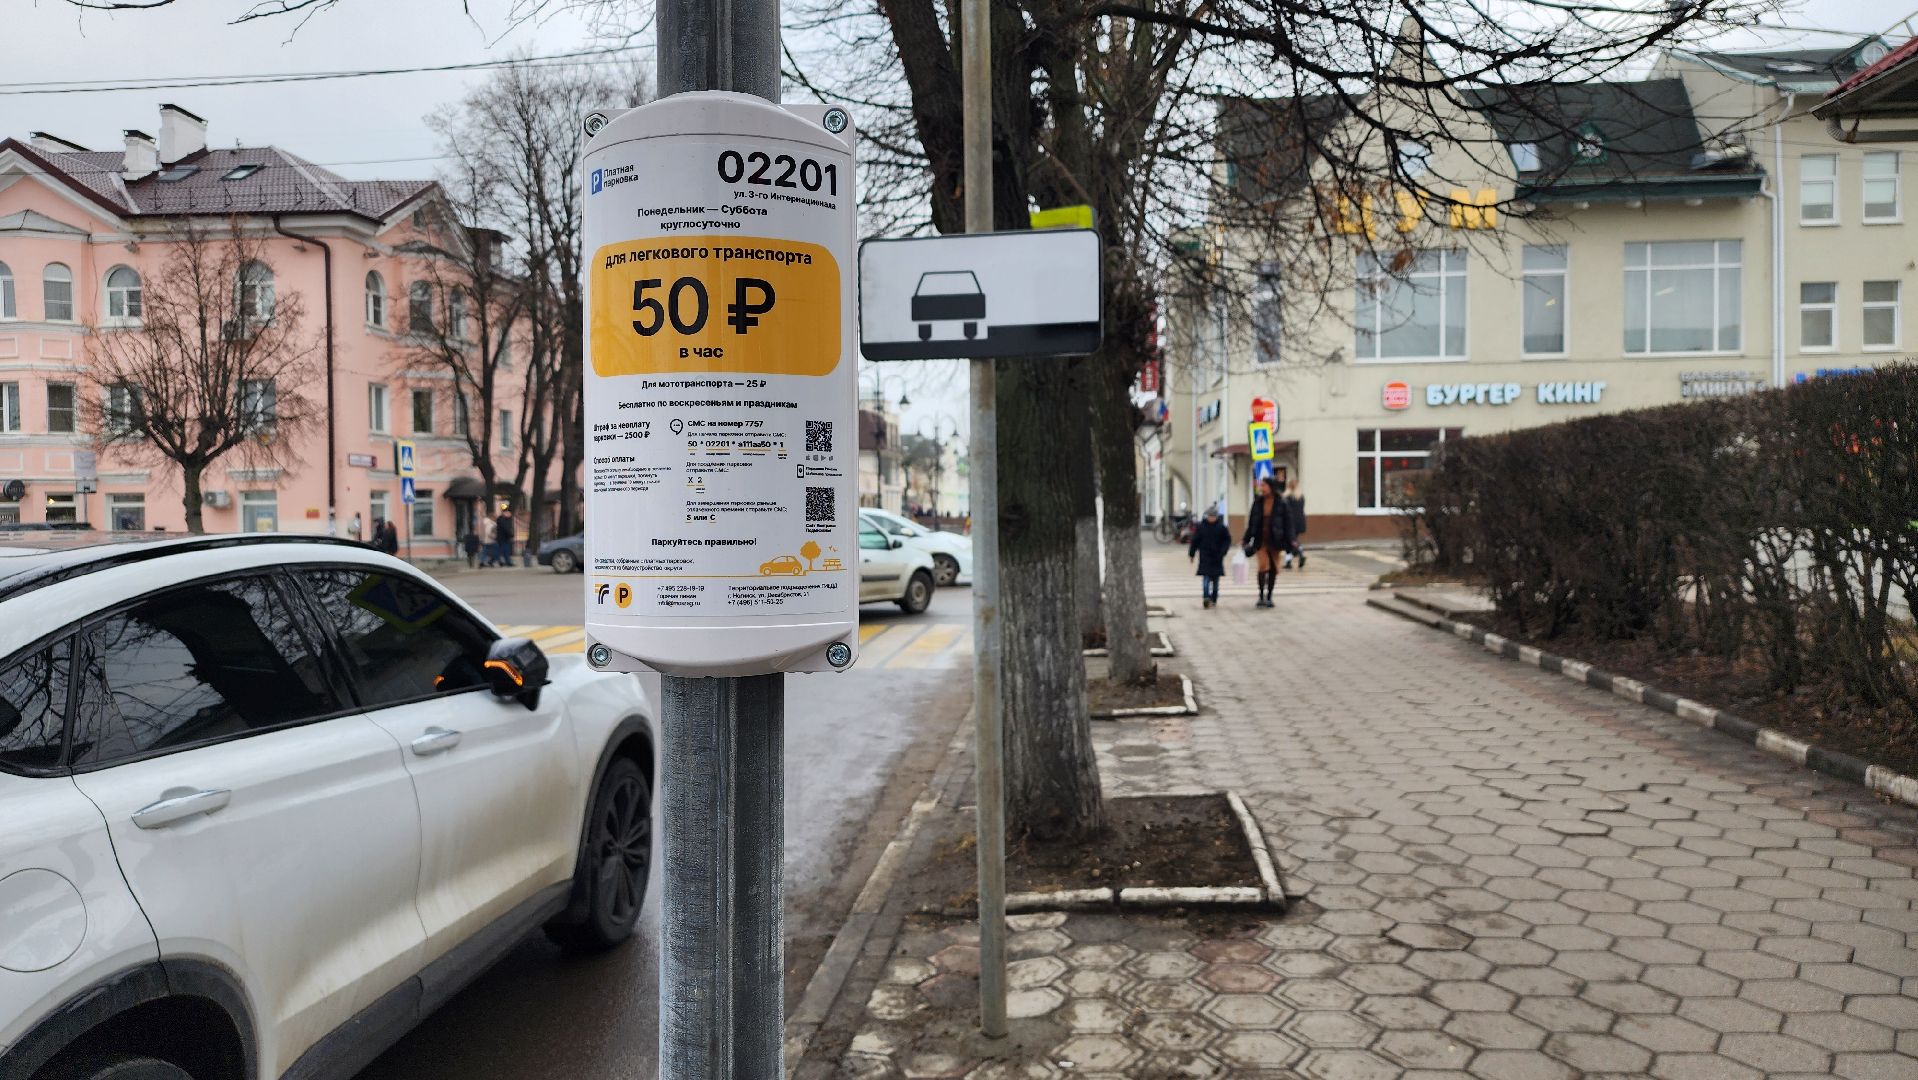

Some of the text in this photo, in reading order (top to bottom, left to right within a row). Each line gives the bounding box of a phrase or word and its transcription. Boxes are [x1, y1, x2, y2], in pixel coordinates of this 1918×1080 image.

[603, 164, 634, 178] Платная
[717, 150, 837, 197] 02201
[603, 174, 639, 188] парковка
[734, 190, 837, 210] ул. 3-го Интернационала
[637, 204, 706, 218] Понедельник
[721, 204, 768, 218] Суббота
[660, 219, 741, 231] круглосуточно
[629, 245, 709, 263] легкового
[713, 246, 812, 267] транспорта
[632, 276, 709, 337] 50
[679, 346, 724, 359] в час
[641, 380, 657, 390] Для
[658, 380, 733, 390] мототранспорта
[746, 380, 758, 388] 25
[1426, 383, 1522, 406] БУРГЕР
[1537, 381, 1608, 404] КИНГ
[618, 401, 656, 410] Бесплатно
[657, 400, 668, 408] по
[669, 400, 733, 409] воскресеньям
[743, 400, 798, 410] праздникам
[618, 421, 651, 430] неоплату
[624, 431, 643, 440] 2500
[651, 537, 757, 548] Паркуйтесь правильно!
